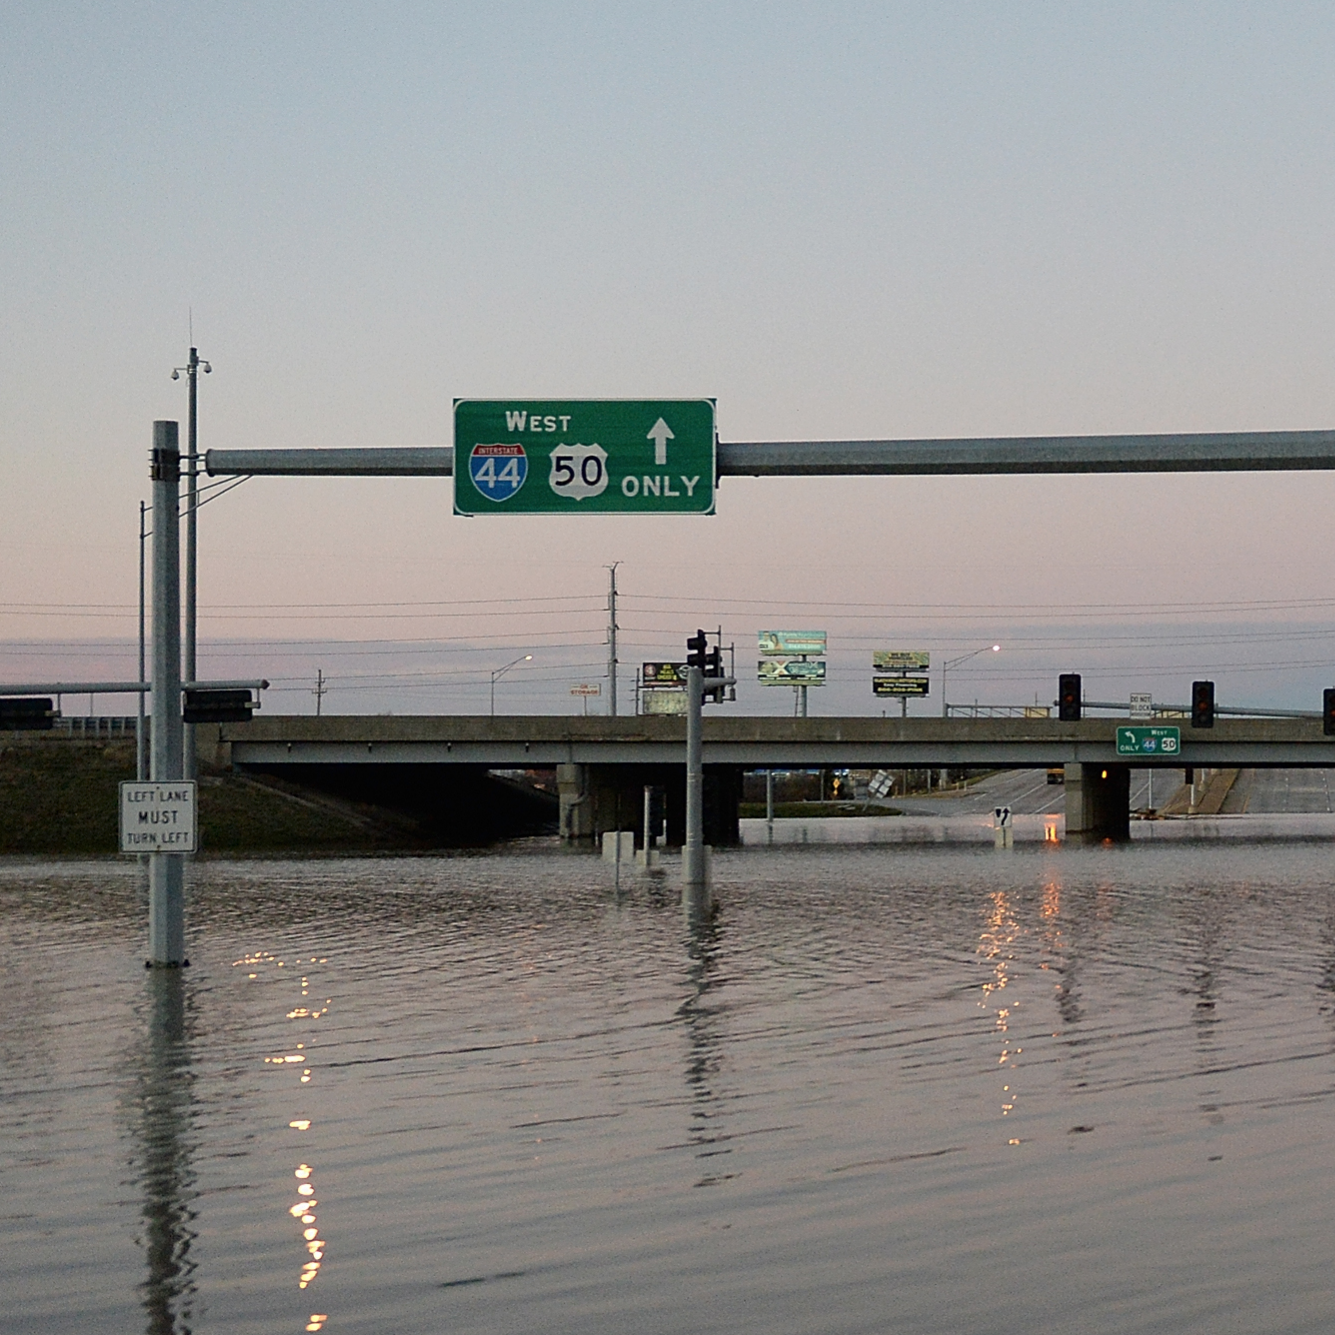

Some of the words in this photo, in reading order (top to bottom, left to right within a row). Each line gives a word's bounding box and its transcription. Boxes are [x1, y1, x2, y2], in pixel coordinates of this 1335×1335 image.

[478, 447, 519, 455] INTERSTATE
[474, 457, 521, 489] 44
[554, 455, 603, 487] 50
[621, 475, 700, 497] ONLY
[1143, 741, 1155, 749] 44
[1162, 740, 1175, 749] 50
[127, 791, 155, 802] LEFT
[160, 790, 189, 802] LANE
[138, 810, 178, 824] MUST
[127, 833, 157, 844] TURN
[162, 832, 189, 843] LEFT
